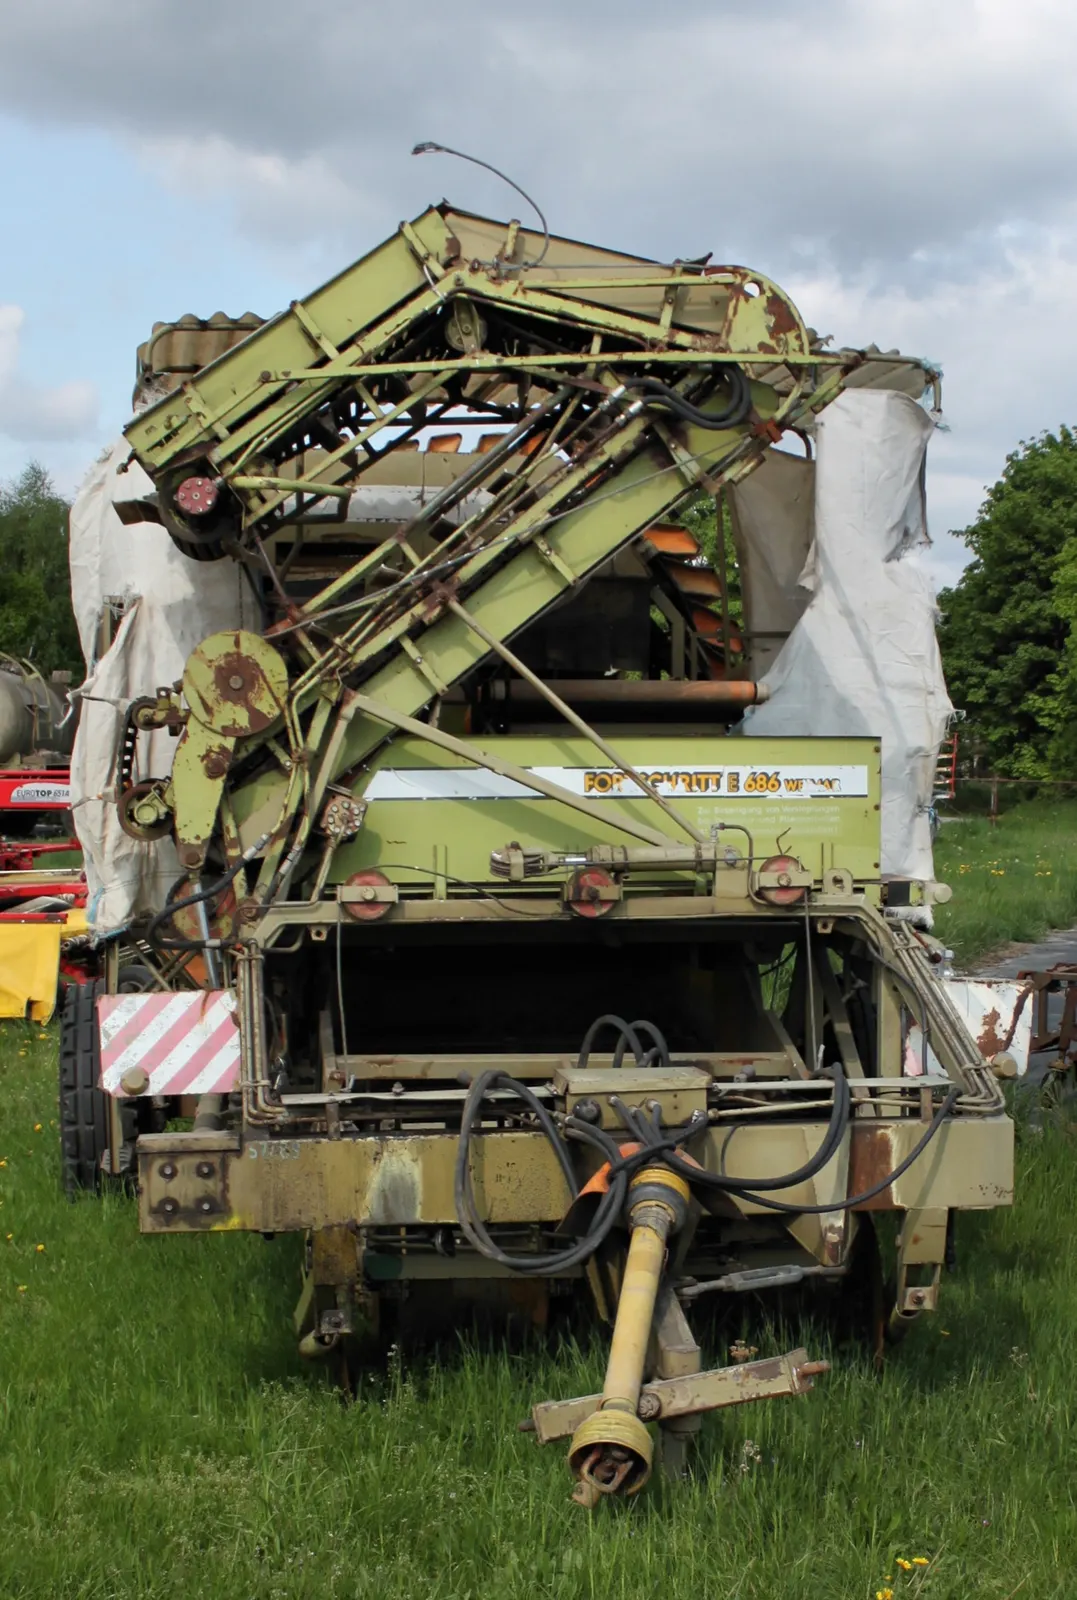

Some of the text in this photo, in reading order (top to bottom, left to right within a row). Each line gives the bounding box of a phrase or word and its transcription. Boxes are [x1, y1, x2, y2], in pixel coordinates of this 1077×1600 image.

[727, 771, 740, 793] E
[743, 771, 781, 793] 686
[16, 789, 52, 797] EUROTOP
